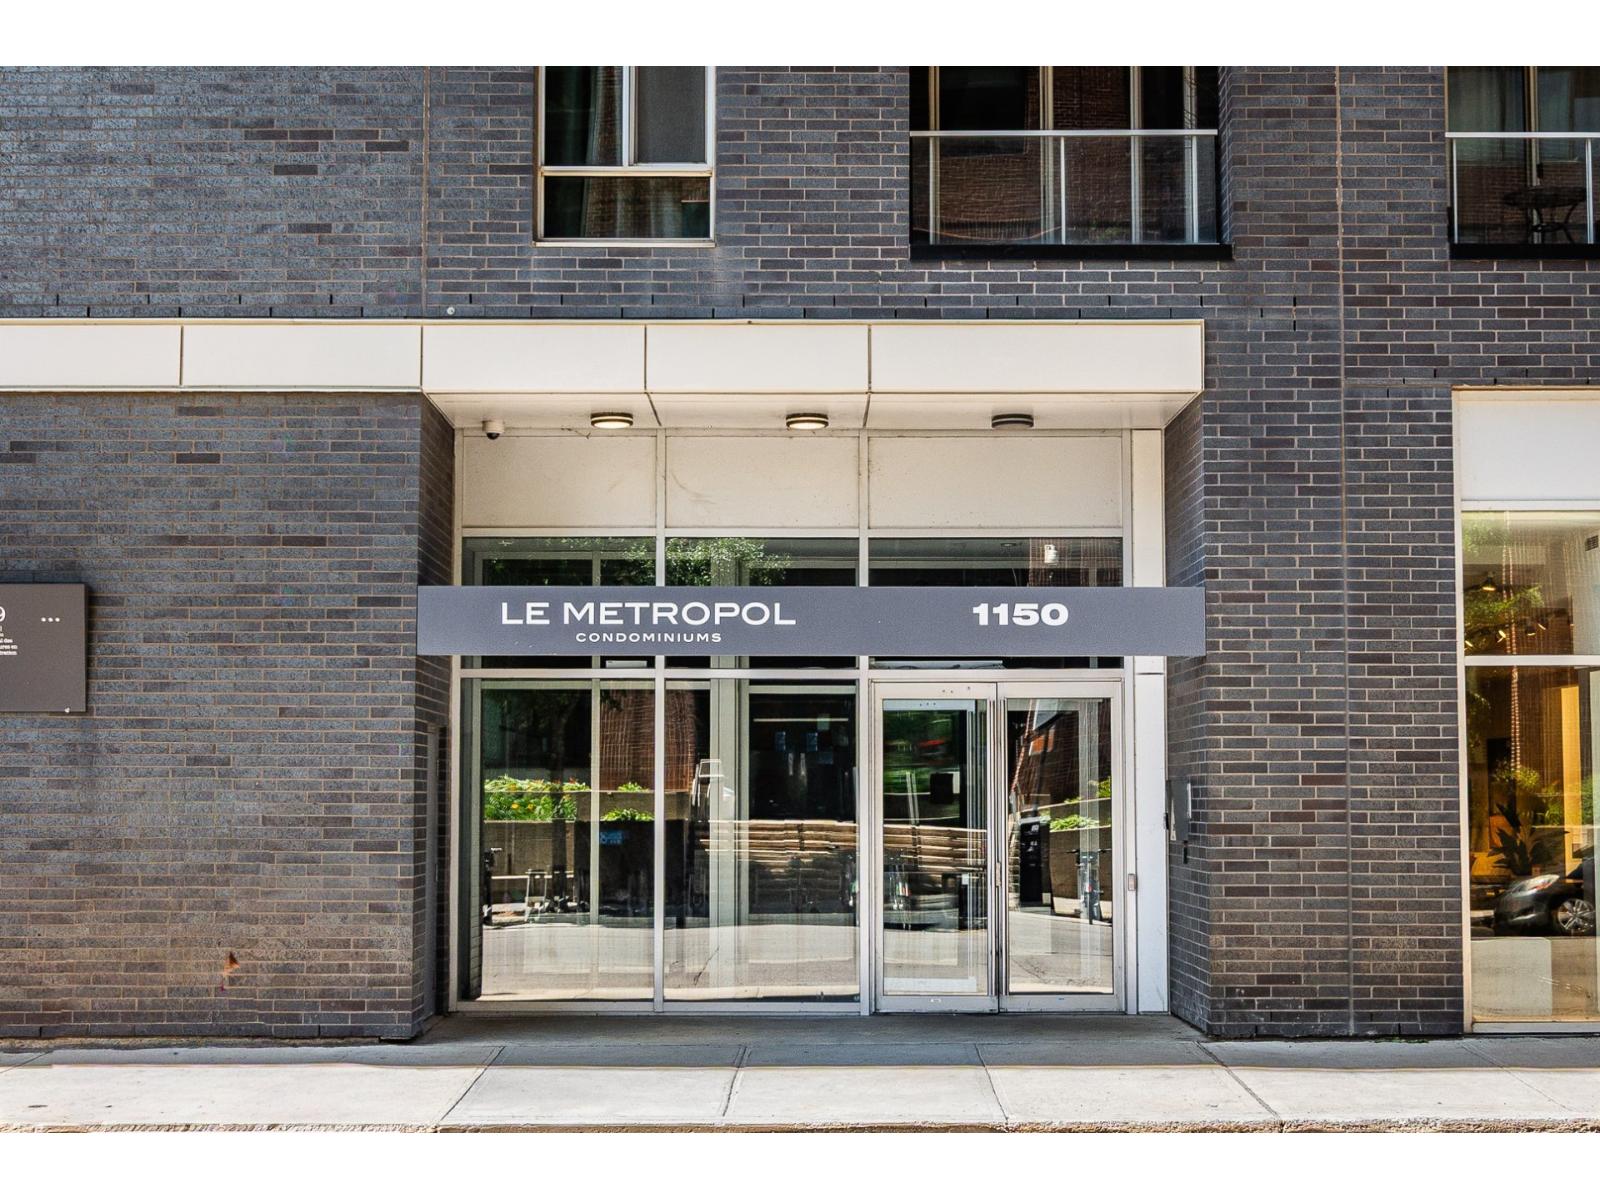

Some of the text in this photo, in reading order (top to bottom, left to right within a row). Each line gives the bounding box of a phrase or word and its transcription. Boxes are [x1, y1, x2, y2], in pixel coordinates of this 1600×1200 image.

[502, 601, 797, 626] LE METROPOL
[972, 603, 1069, 627] 1150
[575, 632, 722, 643] CONDOMINIUMS
